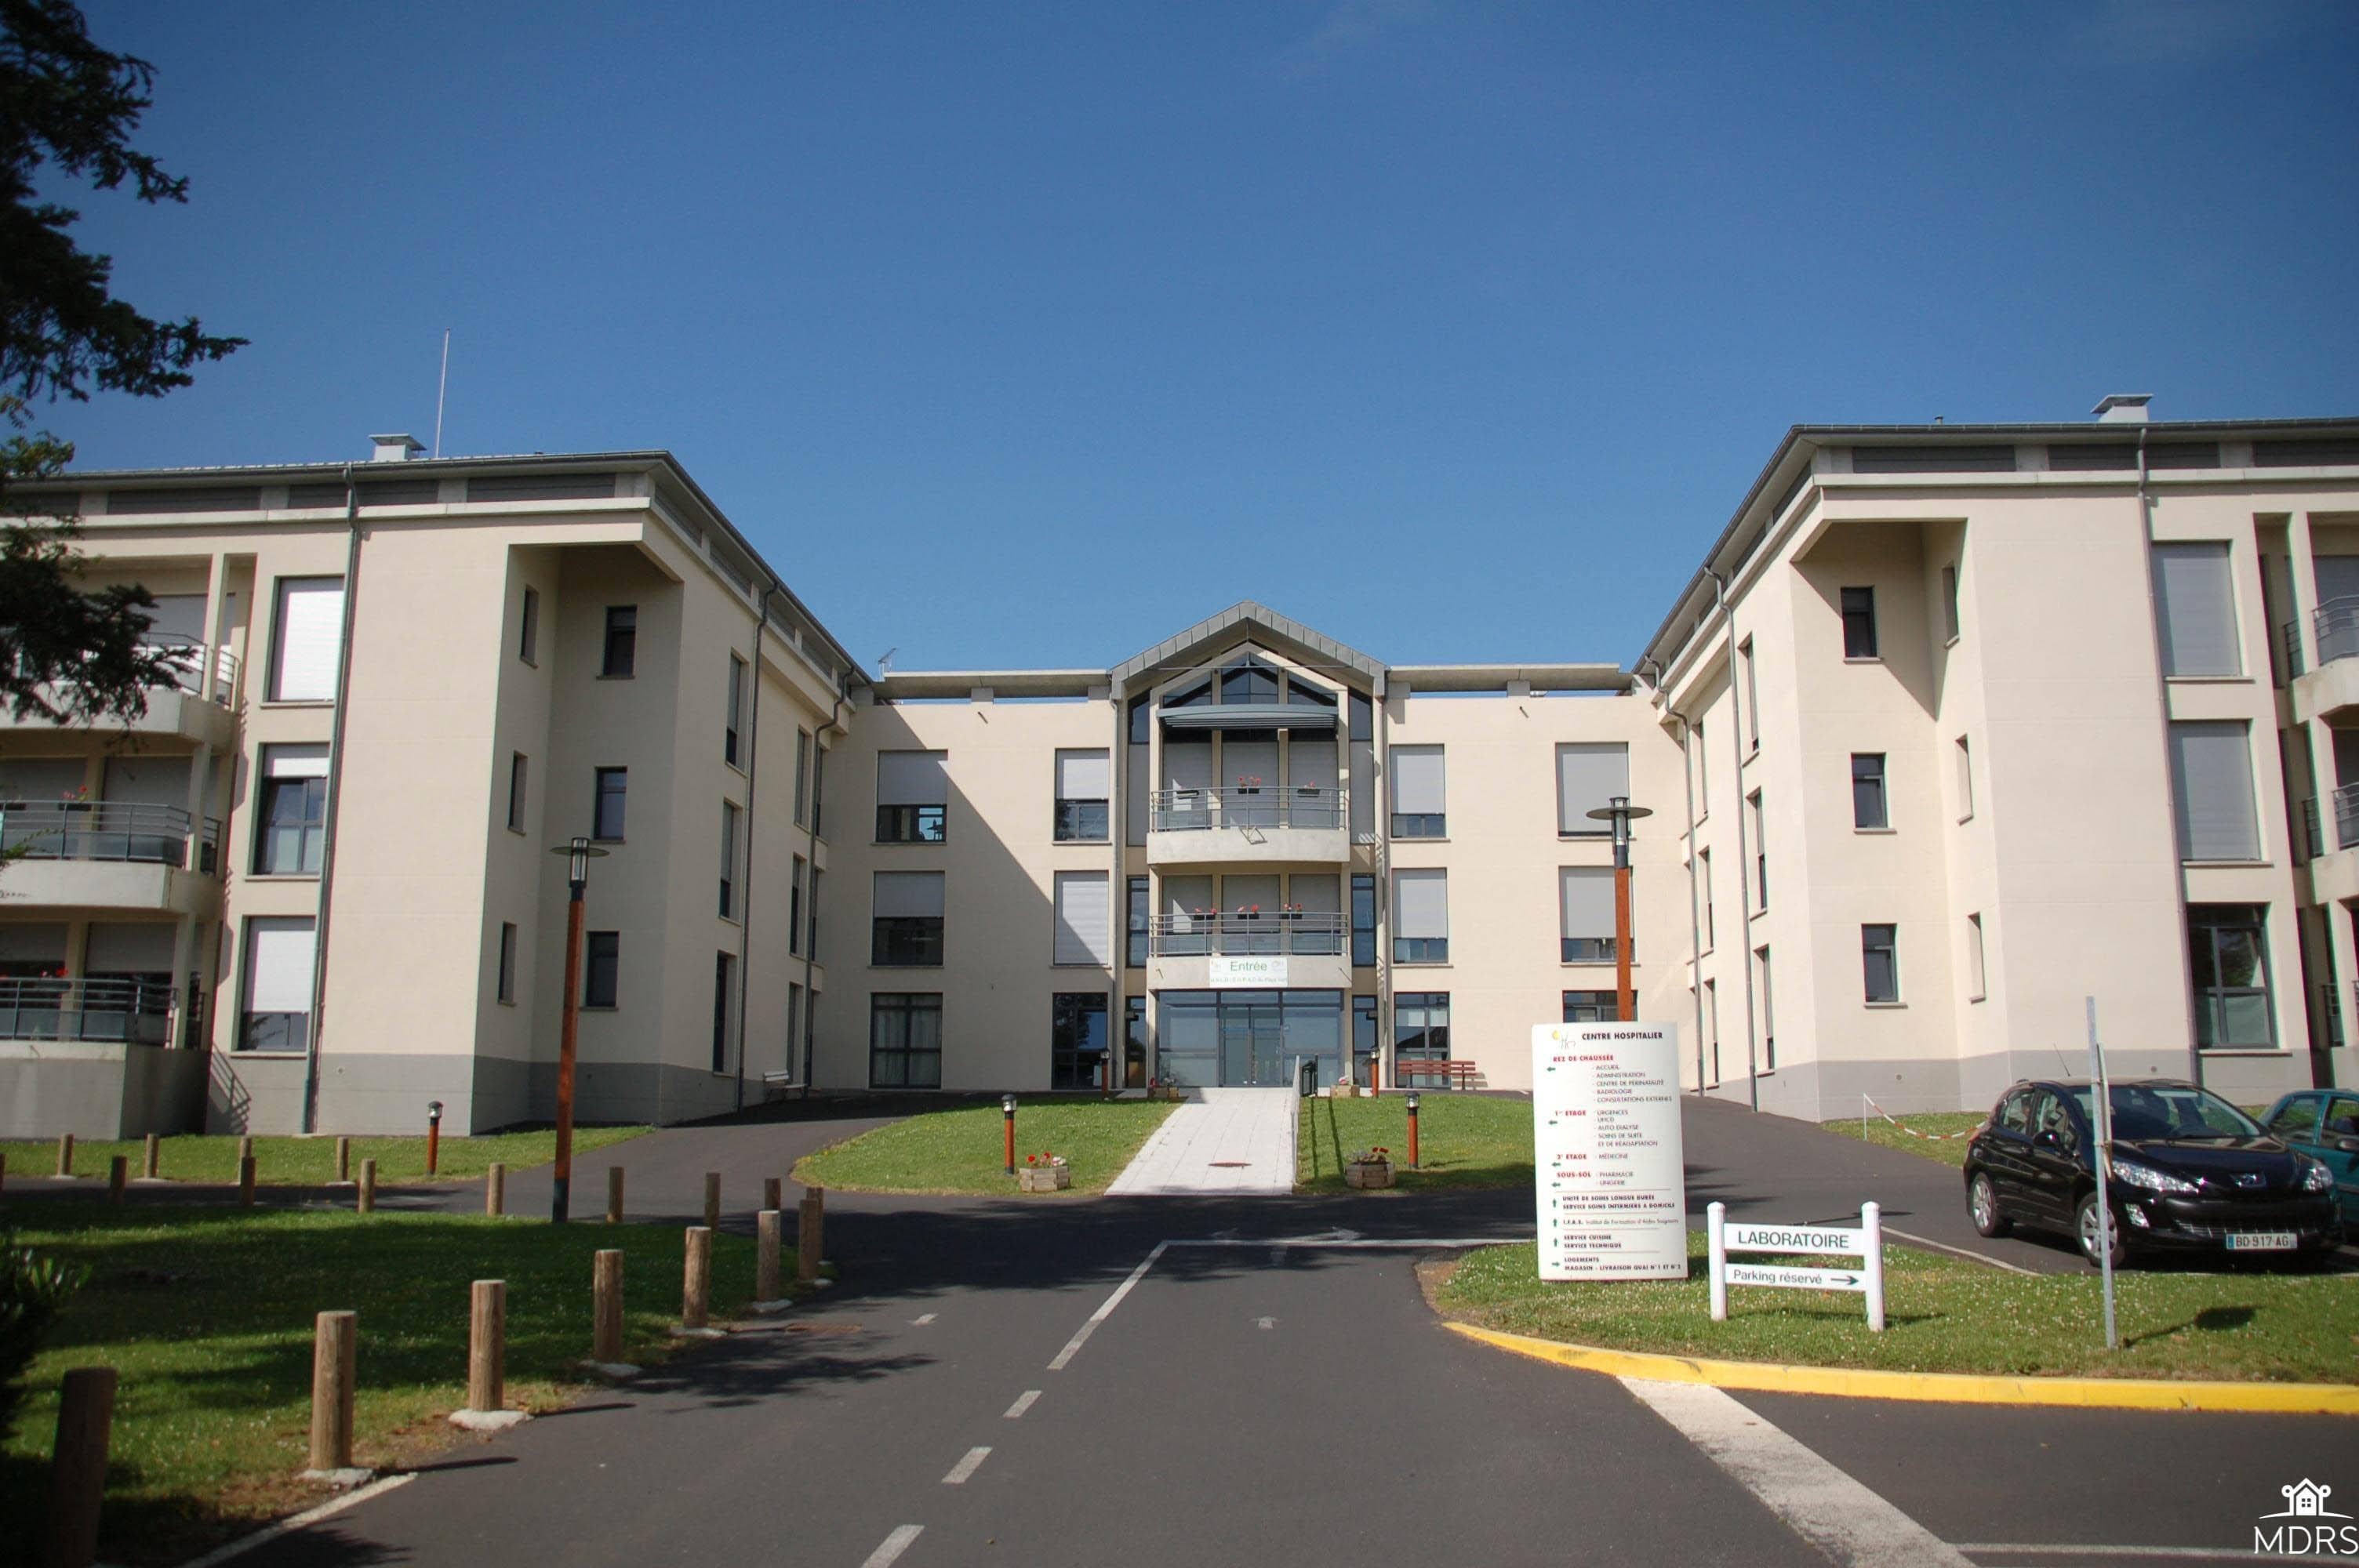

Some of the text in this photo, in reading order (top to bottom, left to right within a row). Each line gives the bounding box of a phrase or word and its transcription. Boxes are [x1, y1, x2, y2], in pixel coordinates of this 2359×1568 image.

[1230, 961, 1267, 971] Entrée
[1738, 1231, 1849, 1249] LABORATOIRE
[1733, 1269, 1822, 1284] Parking réservé
